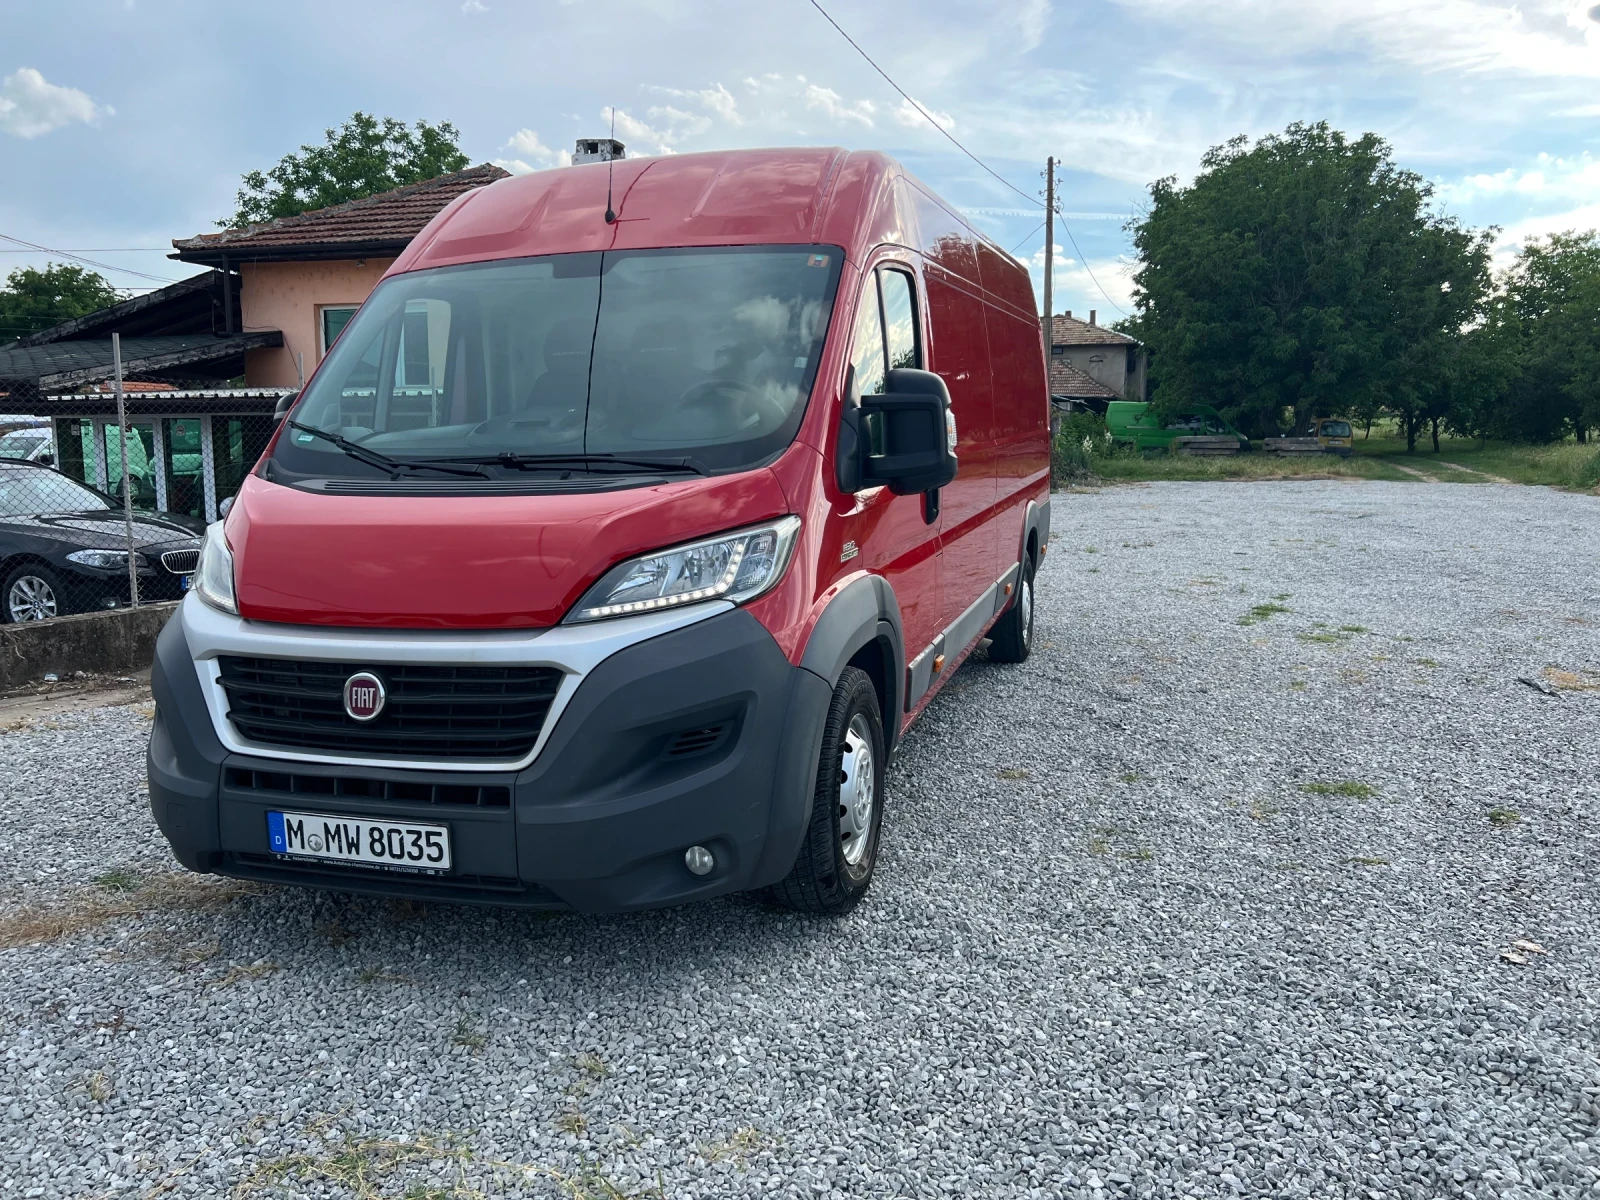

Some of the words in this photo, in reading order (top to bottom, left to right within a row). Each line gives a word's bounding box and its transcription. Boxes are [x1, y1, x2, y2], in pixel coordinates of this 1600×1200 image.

[352, 687, 376, 709] FIAT
[275, 836, 282, 845] D
[323, 821, 360, 856] MW
[368, 826, 444, 862] 8035
